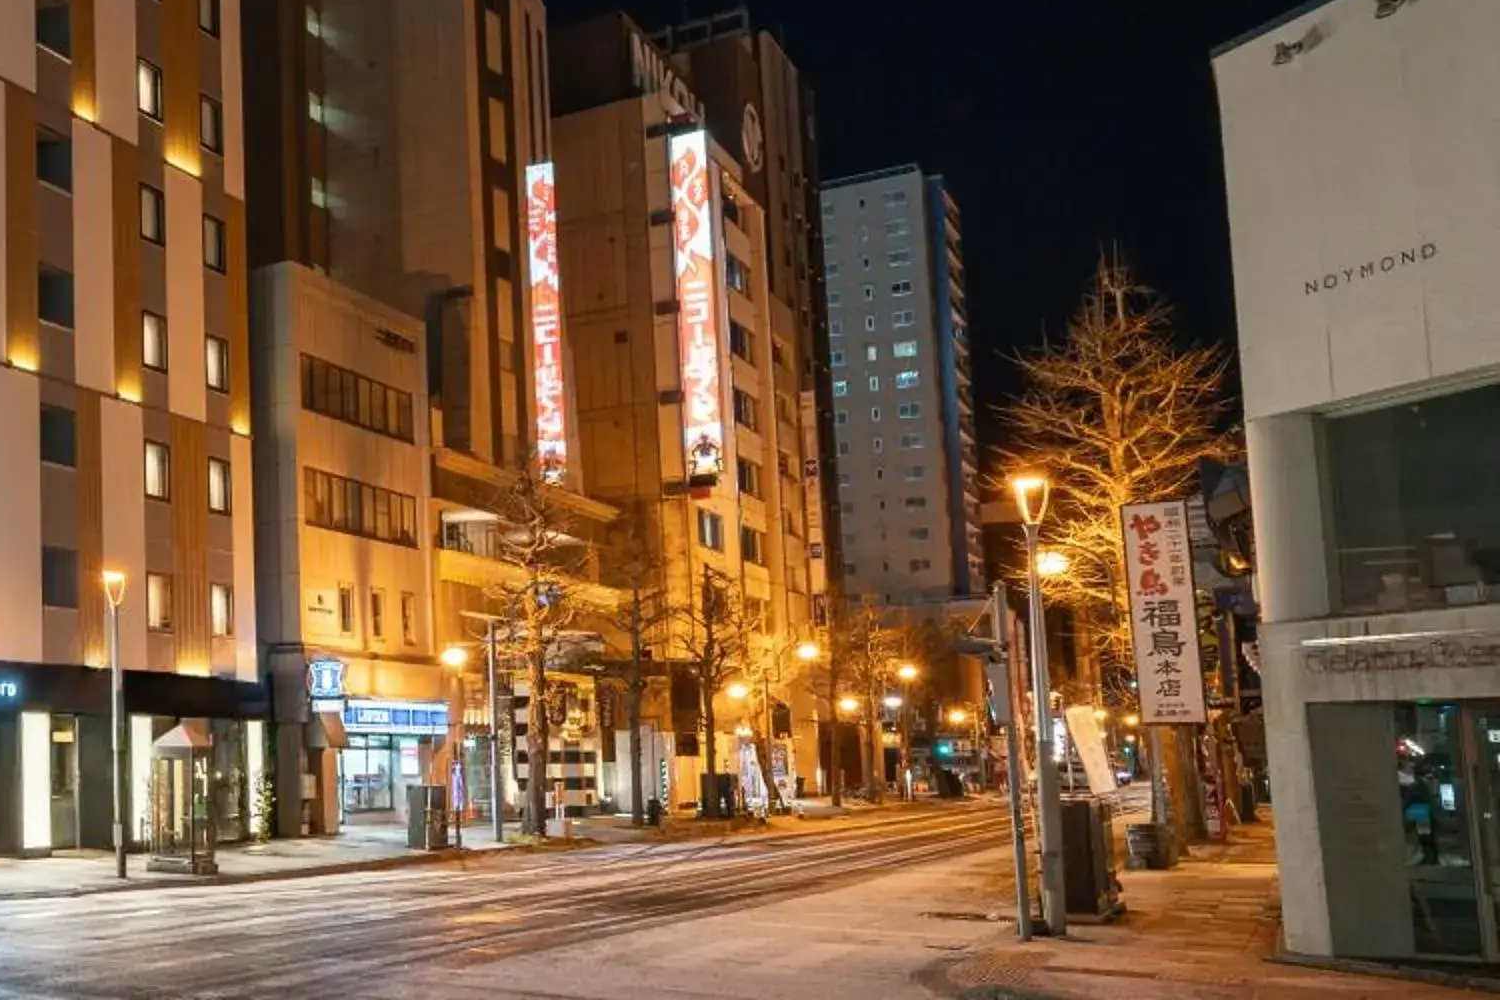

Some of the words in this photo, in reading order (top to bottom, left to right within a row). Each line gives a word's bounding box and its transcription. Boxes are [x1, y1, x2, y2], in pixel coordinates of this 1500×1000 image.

[1304, 243, 1437, 295] NOYMOND
[1129, 513, 1169, 597] やき鳥
